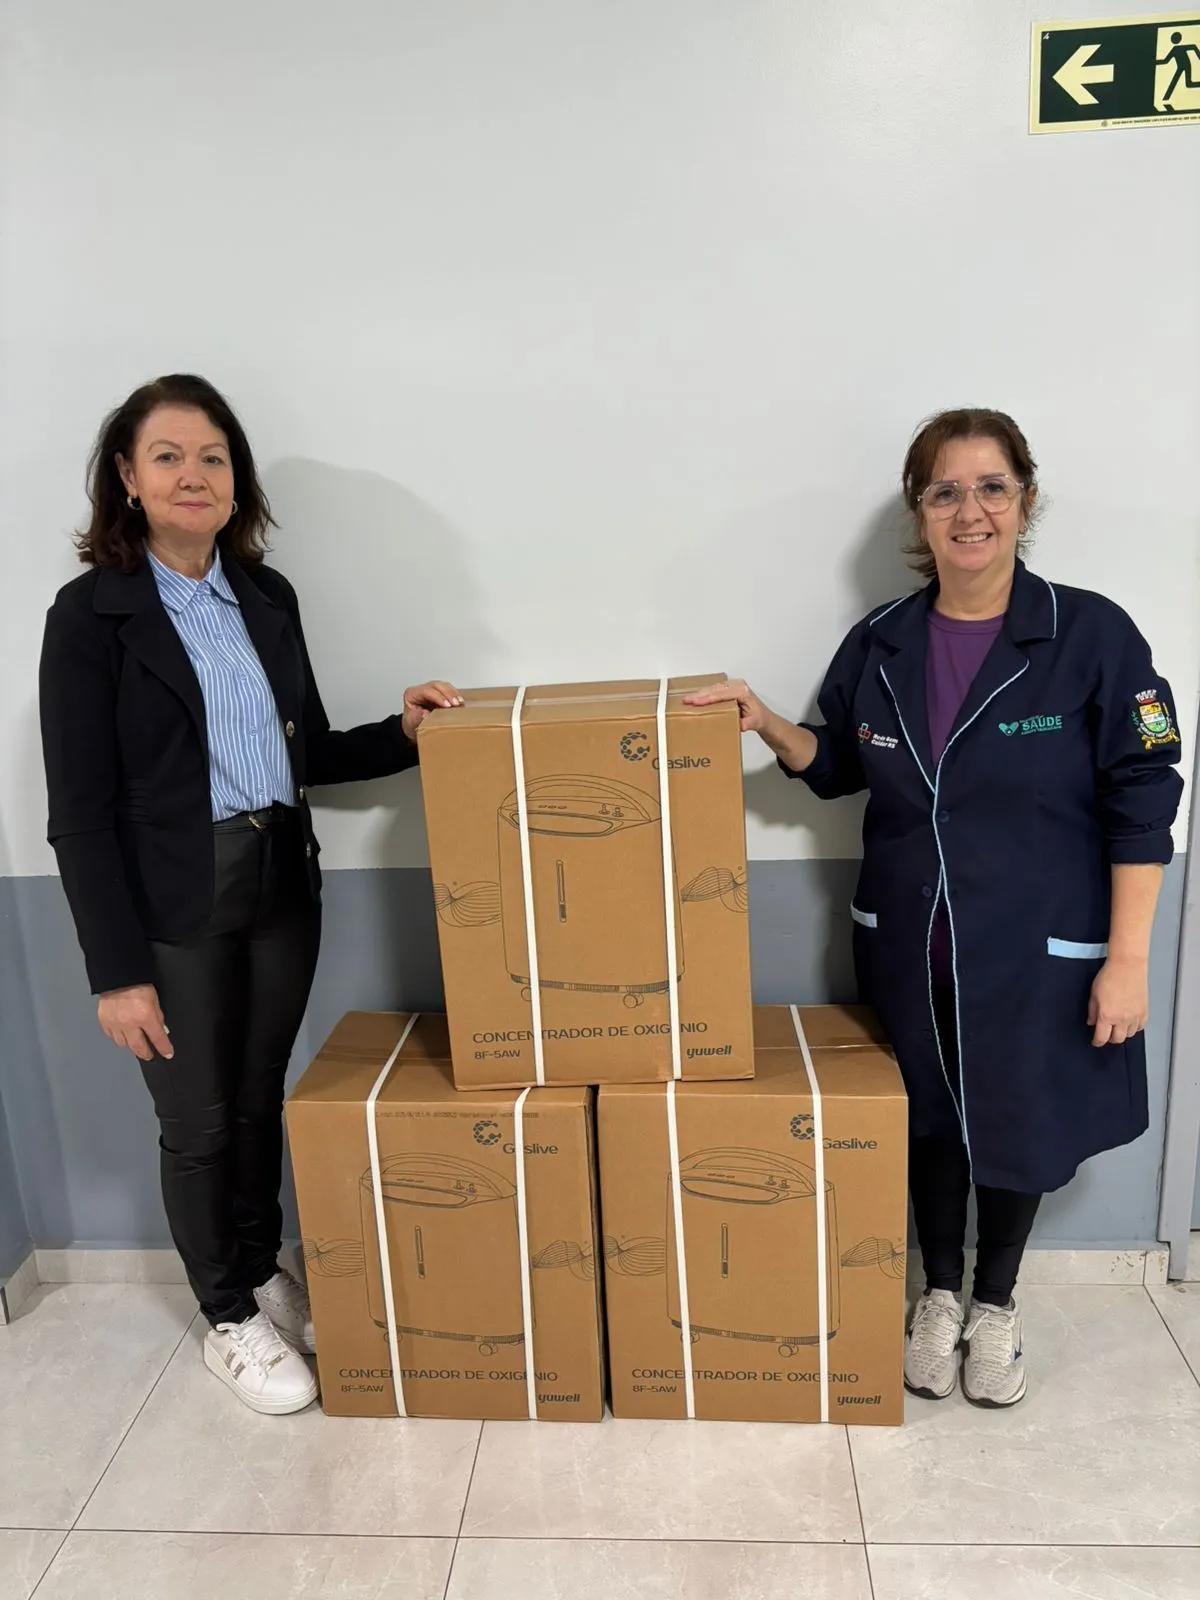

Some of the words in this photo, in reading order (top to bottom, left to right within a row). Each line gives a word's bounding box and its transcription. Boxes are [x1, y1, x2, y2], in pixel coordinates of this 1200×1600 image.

[608, 1025, 629, 1037] DE
[633, 1022, 708, 1036] OXIGNIO
[686, 1045, 732, 1059] yuwell
[502, 1143, 559, 1155] Gslive
[822, 1137, 878, 1150] Gaslive
[464, 1370, 485, 1380] DE
[631, 1368, 758, 1381] CONCETRADOR
[762, 1371, 783, 1382] DE
[537, 1393, 580, 1404] yuwell
[836, 1395, 882, 1406] yuwell
